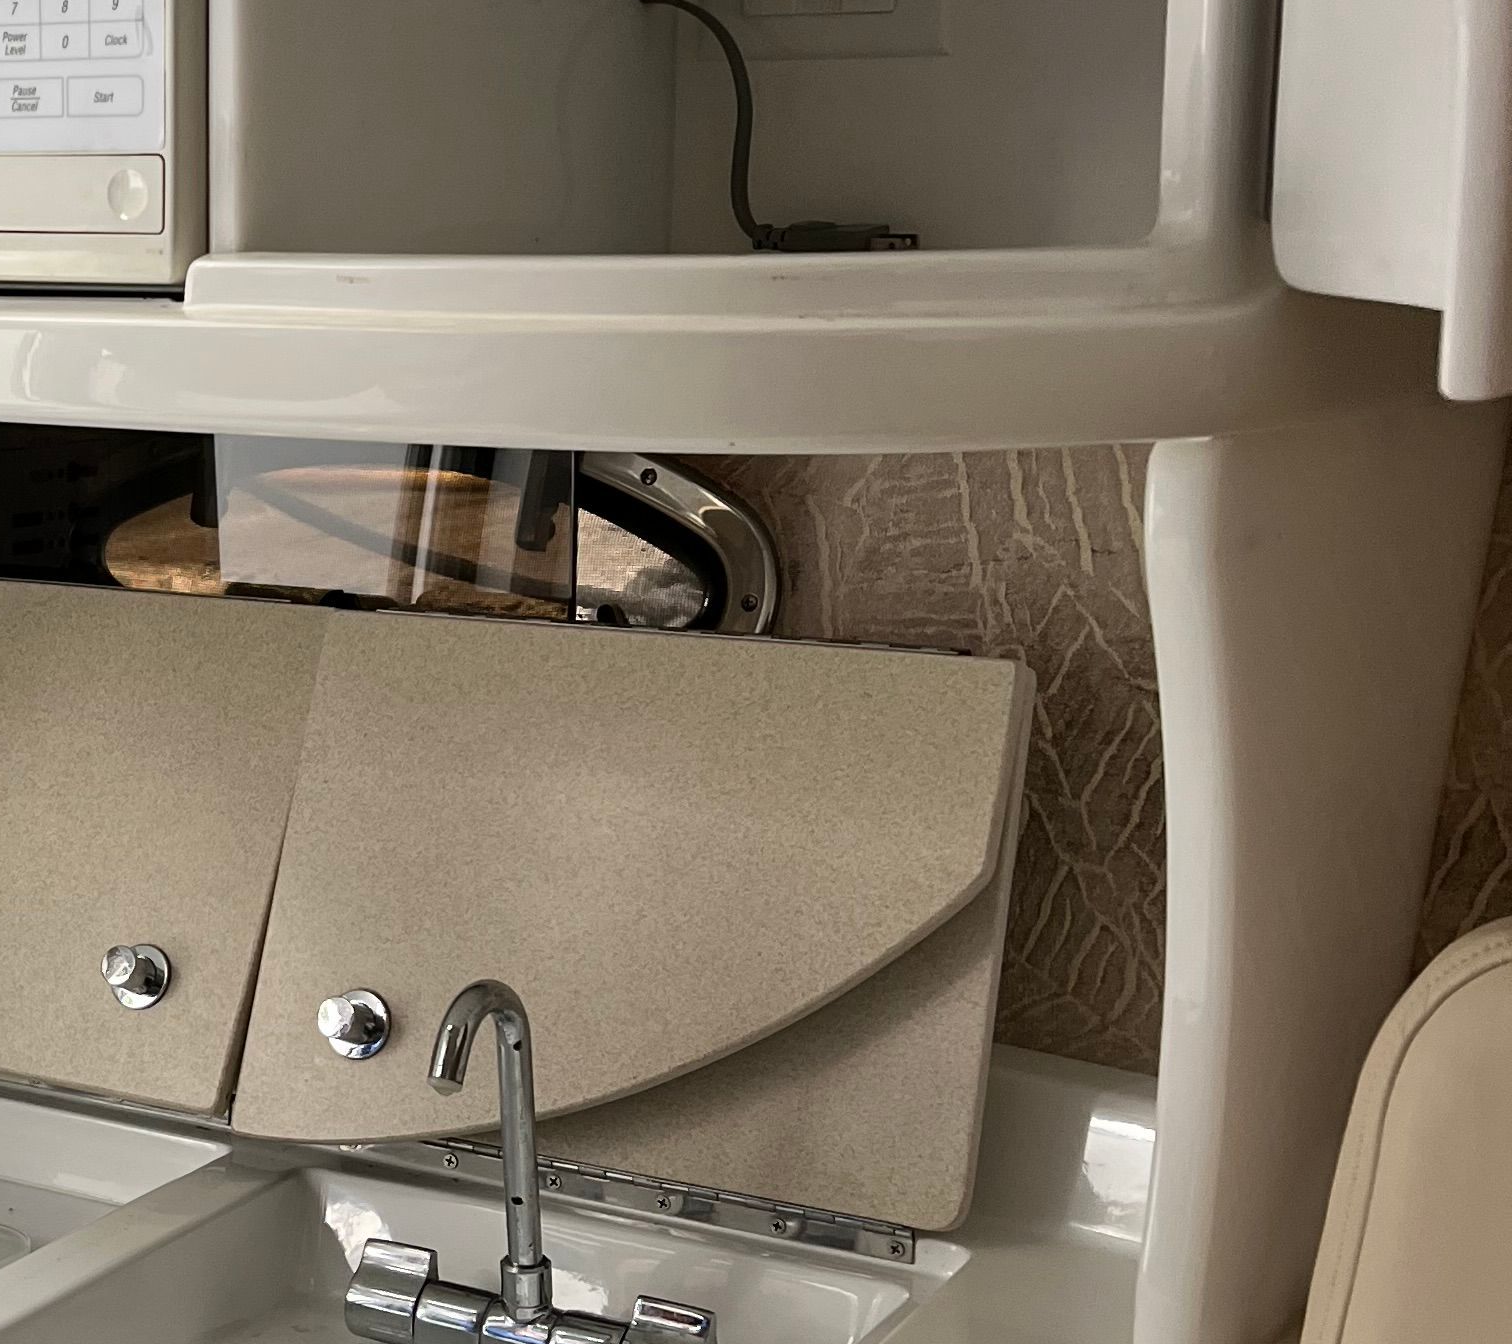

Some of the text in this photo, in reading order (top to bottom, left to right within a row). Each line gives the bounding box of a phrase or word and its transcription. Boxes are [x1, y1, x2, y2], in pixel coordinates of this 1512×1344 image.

[12, 1, 18, 16] 7
[62, 0, 69, 15] 8
[1, 31, 28, 45] Power
[62, 34, 69, 49] 0
[104, 33, 128, 47] Clock
[4, 42, 26, 57] Level
[11, 84, 37, 97] Pause
[93, 91, 114, 105] Start
[11, 99, 40, 113] Cancel
